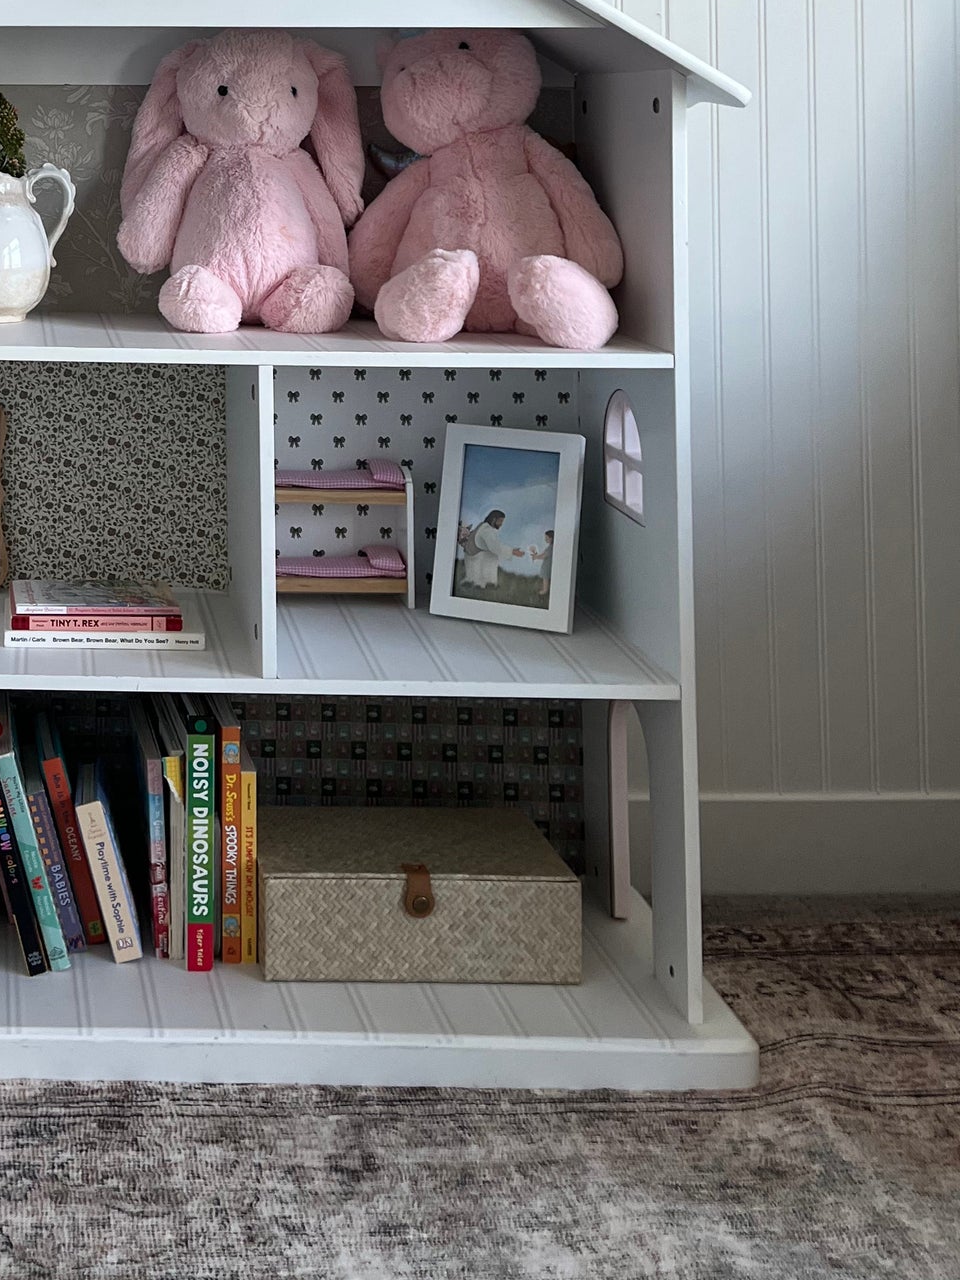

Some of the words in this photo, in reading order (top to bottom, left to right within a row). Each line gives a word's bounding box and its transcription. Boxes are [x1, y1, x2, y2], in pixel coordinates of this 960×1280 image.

[192, 744, 209, 801] NOISY
[225, 774, 236, 789] Dr.
[2, 777, 17, 816] Sunshine
[226, 791, 237, 822] Seuss's
[66, 826, 82, 861] OCEAN?
[192, 807, 209, 916] DINOSAURS
[226, 825, 238, 865] SPOOKY
[246, 842, 254, 873] PUMPKIN
[6, 854, 18, 884] colors
[51, 864, 70, 906] BABIES
[225, 868, 237, 904] THINGS
[96, 842, 112, 881] Playtime
[104, 883, 116, 902] with
[111, 902, 125, 934] Sophie
